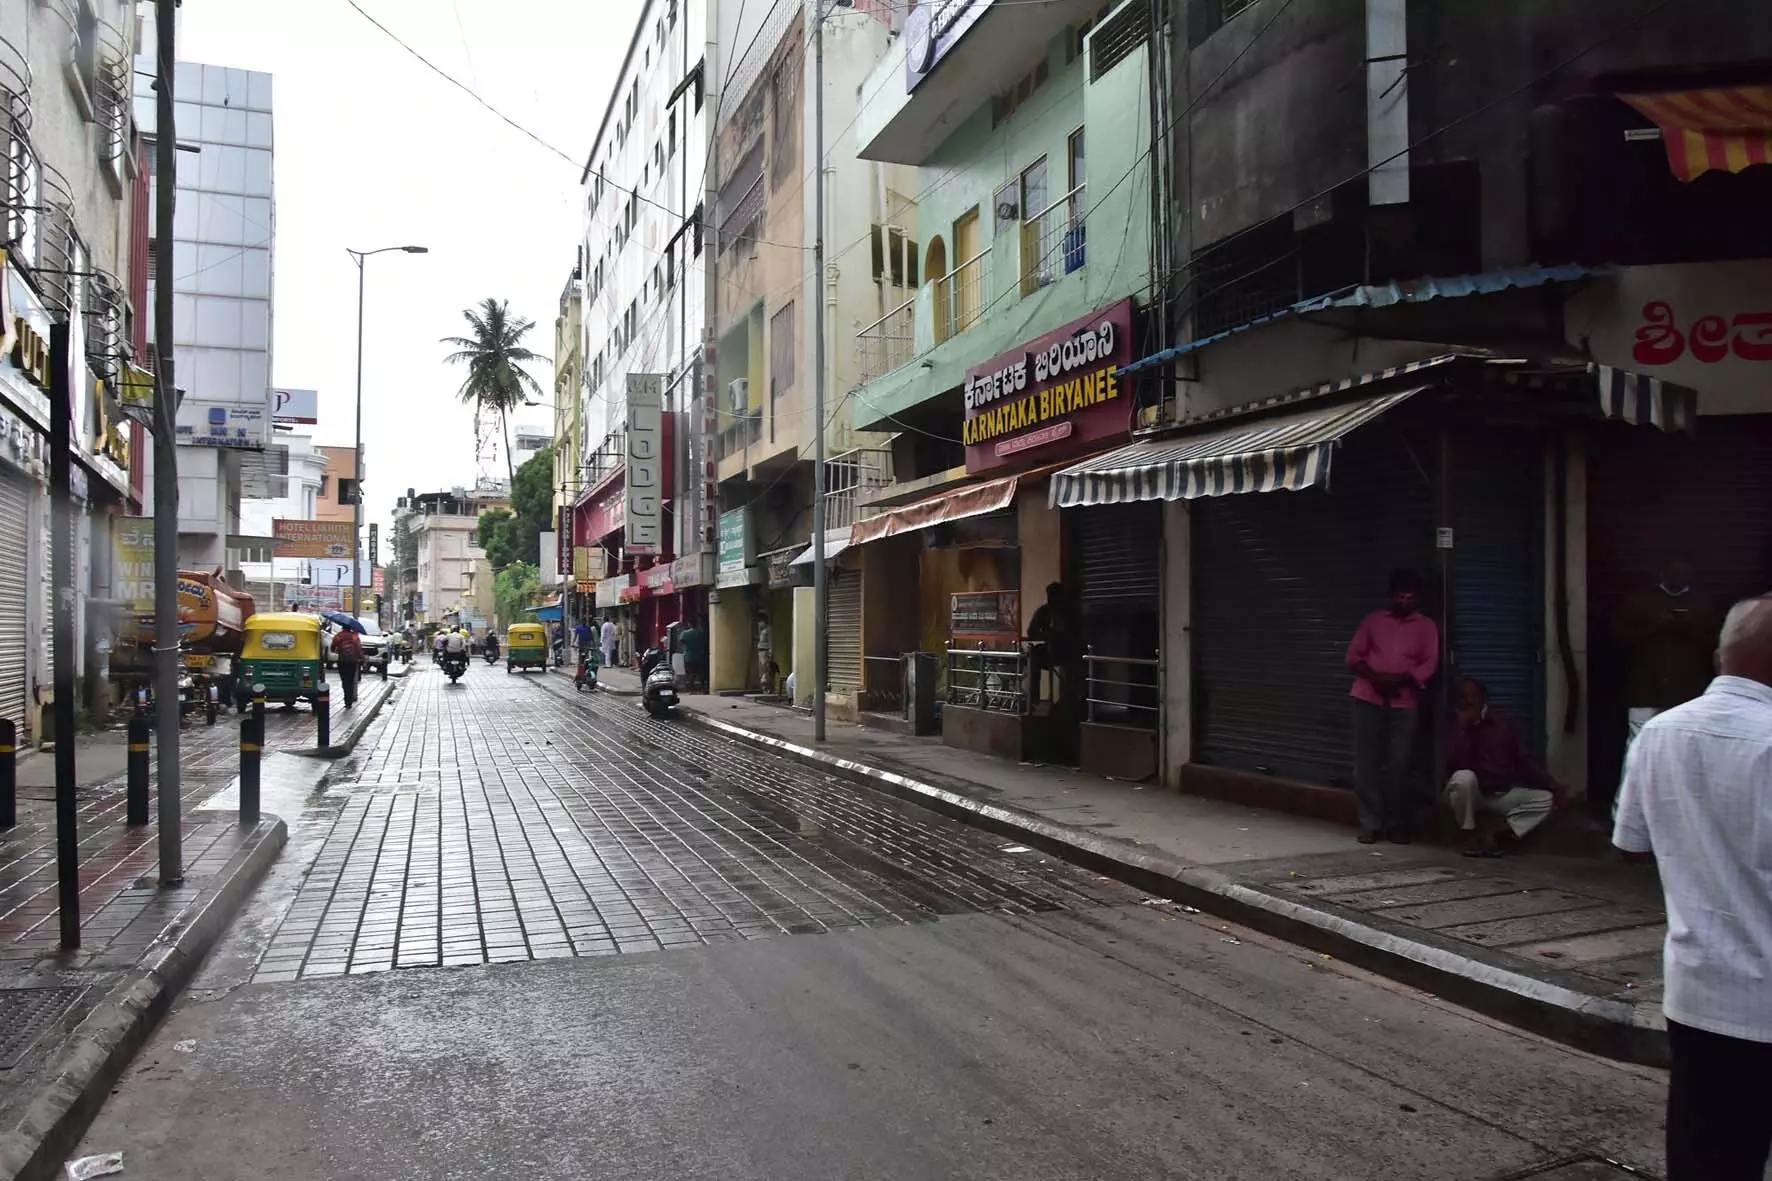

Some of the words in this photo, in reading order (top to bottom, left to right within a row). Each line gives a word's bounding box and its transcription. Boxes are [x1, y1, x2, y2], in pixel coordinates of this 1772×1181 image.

[963, 396, 1037, 446] KARNATAKA
[1040, 365, 1118, 420] BIRYANEE
[964, 353, 1027, 409] ಕರ್ನಾಟಕ
[1035, 320, 1114, 382] ಬಿರಿಯಾನಿ
[630, 408, 656, 546] LODGE
[279, 522, 310, 532] HOTEL
